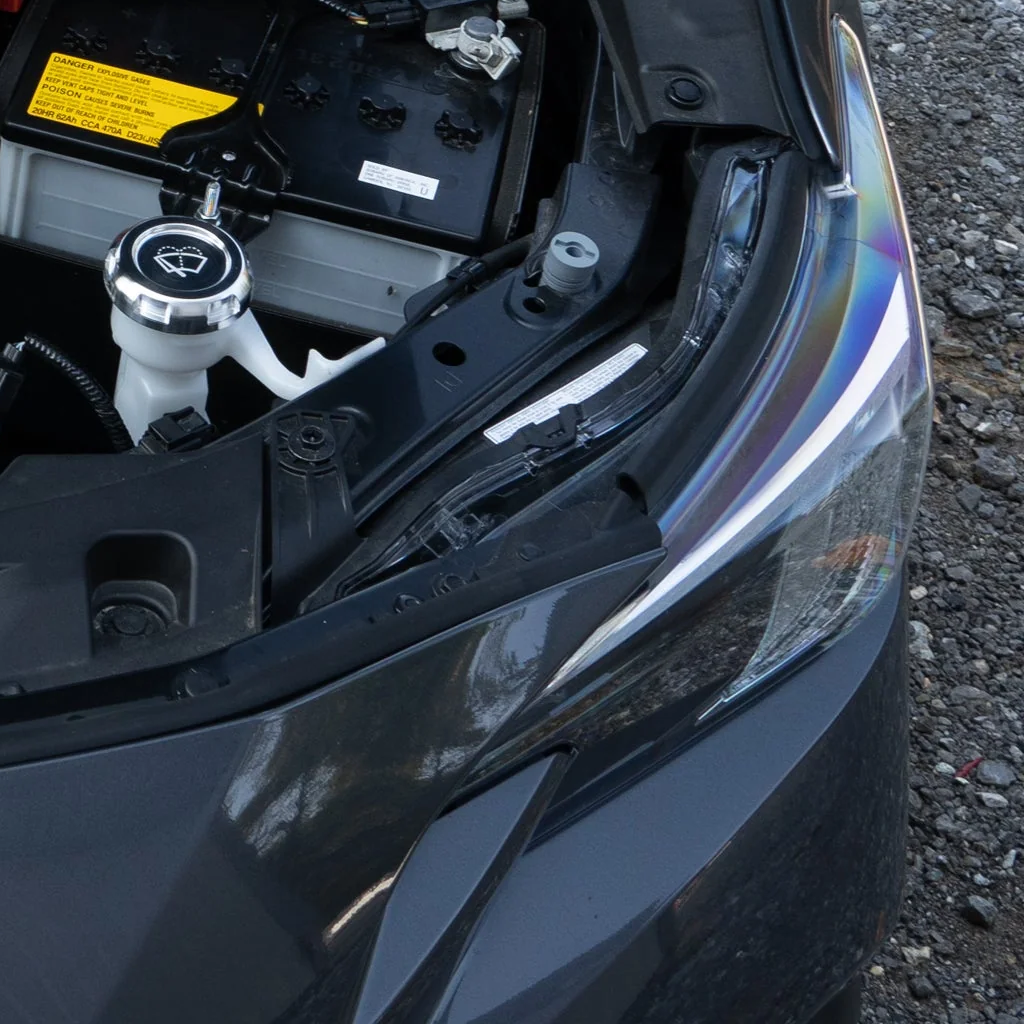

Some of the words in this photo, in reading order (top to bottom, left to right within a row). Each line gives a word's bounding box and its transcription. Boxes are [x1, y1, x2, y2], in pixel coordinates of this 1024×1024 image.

[52, 56, 94, 71] DANGER
[97, 68, 129, 81] EXPLOSIVE
[130, 76, 151, 86] GASES
[42, 83, 82, 99] POISON
[84, 95, 109, 106] CAUSES
[110, 101, 134, 111] SEVERE
[134, 107, 155, 117] BURNS
[45, 76, 61, 85] KEEP
[62, 81, 77, 89] VENT
[78, 85, 94, 93] CAPS
[96, 89, 115, 98] TIGHT
[130, 97, 148, 107] LEVEL
[31, 106, 55, 118] 20HR
[56, 113, 77, 124] 62Ah
[80, 119, 100, 131] CCA
[102, 125, 122, 136] 470A
[34, 100, 52, 108] KEEP
[76, 110, 99, 120] REACH
[108, 117, 139, 130] CHILDREN
[420, 187, 428, 196] U
